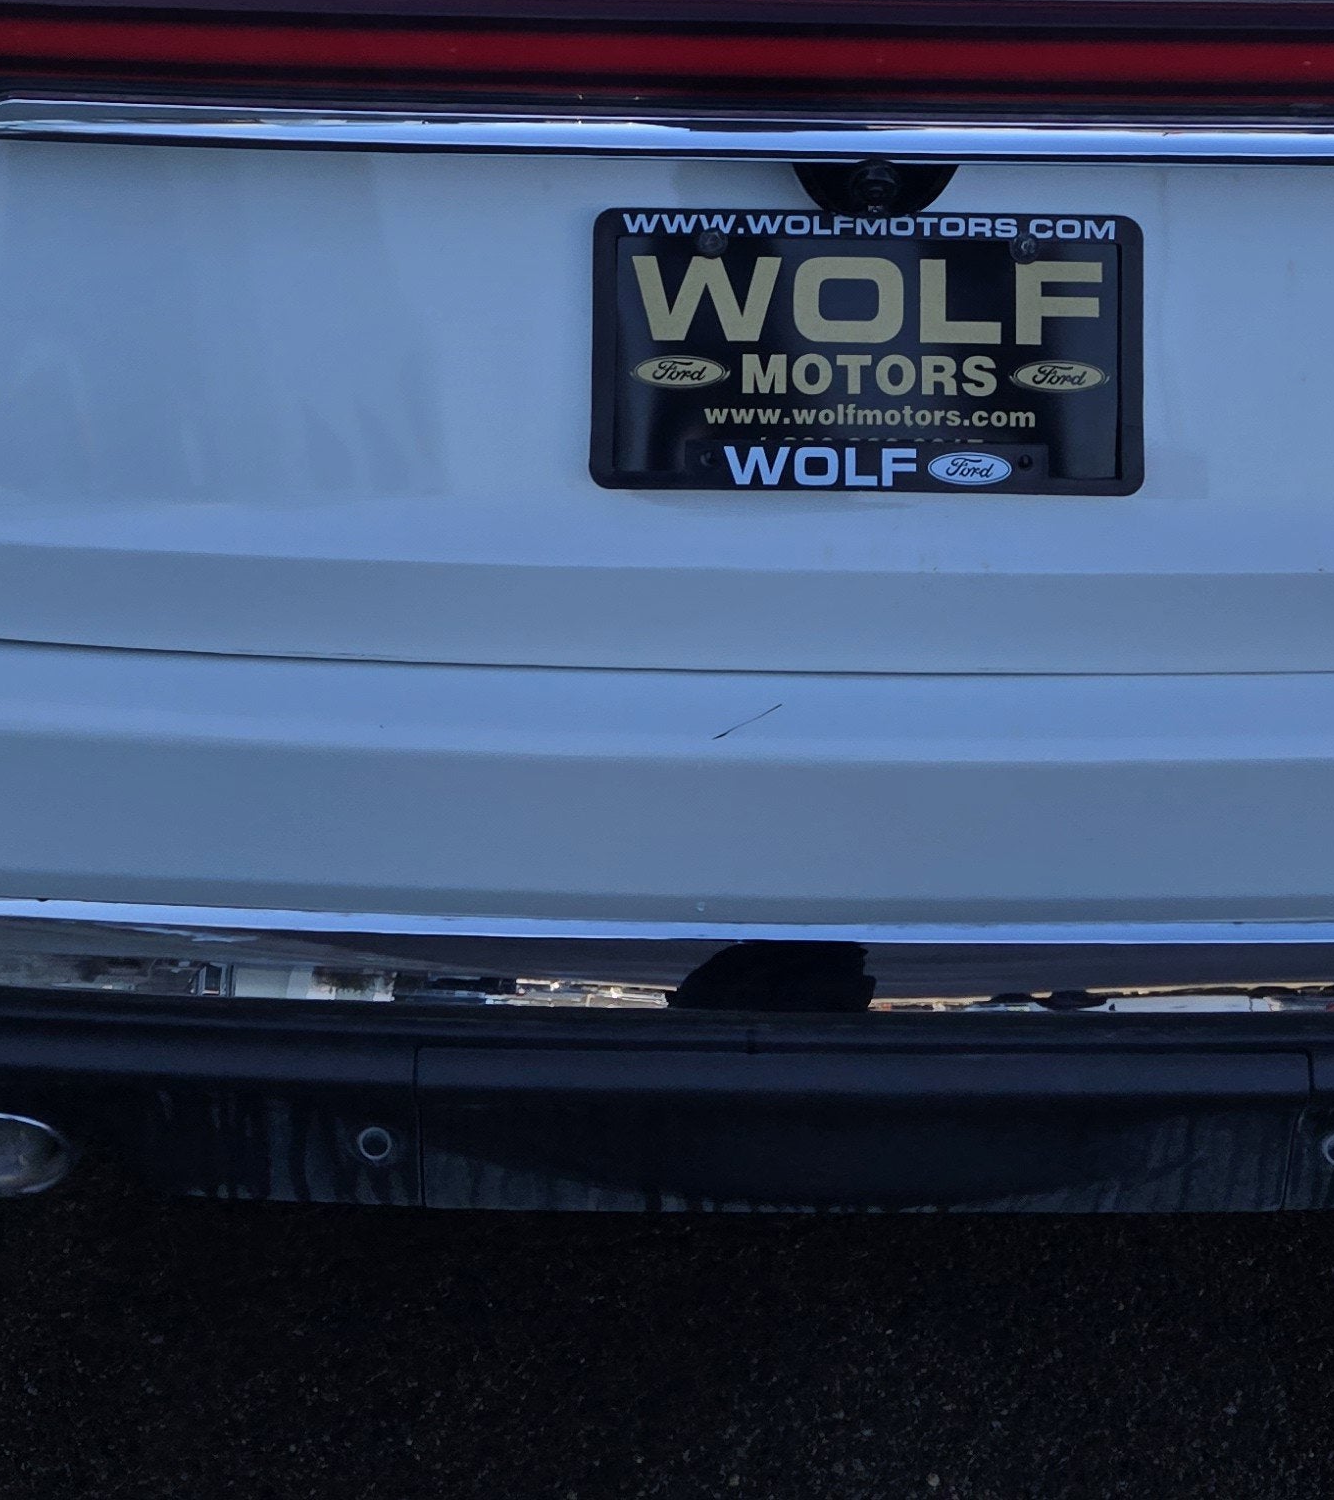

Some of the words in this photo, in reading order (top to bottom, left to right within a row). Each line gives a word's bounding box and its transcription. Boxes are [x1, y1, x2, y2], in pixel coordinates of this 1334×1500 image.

[622, 212, 1116, 241] WWW.WOLFMOTORSCOM
[632, 255, 1103, 346] WOLF
[650, 359, 708, 383] Ford
[741, 353, 998, 398] MOTORS
[1030, 364, 1088, 388] Ford
[703, 402, 1037, 430] www.wolfmotors.com
[723, 445, 917, 487] WOLF
[945, 457, 995, 479] Ford
